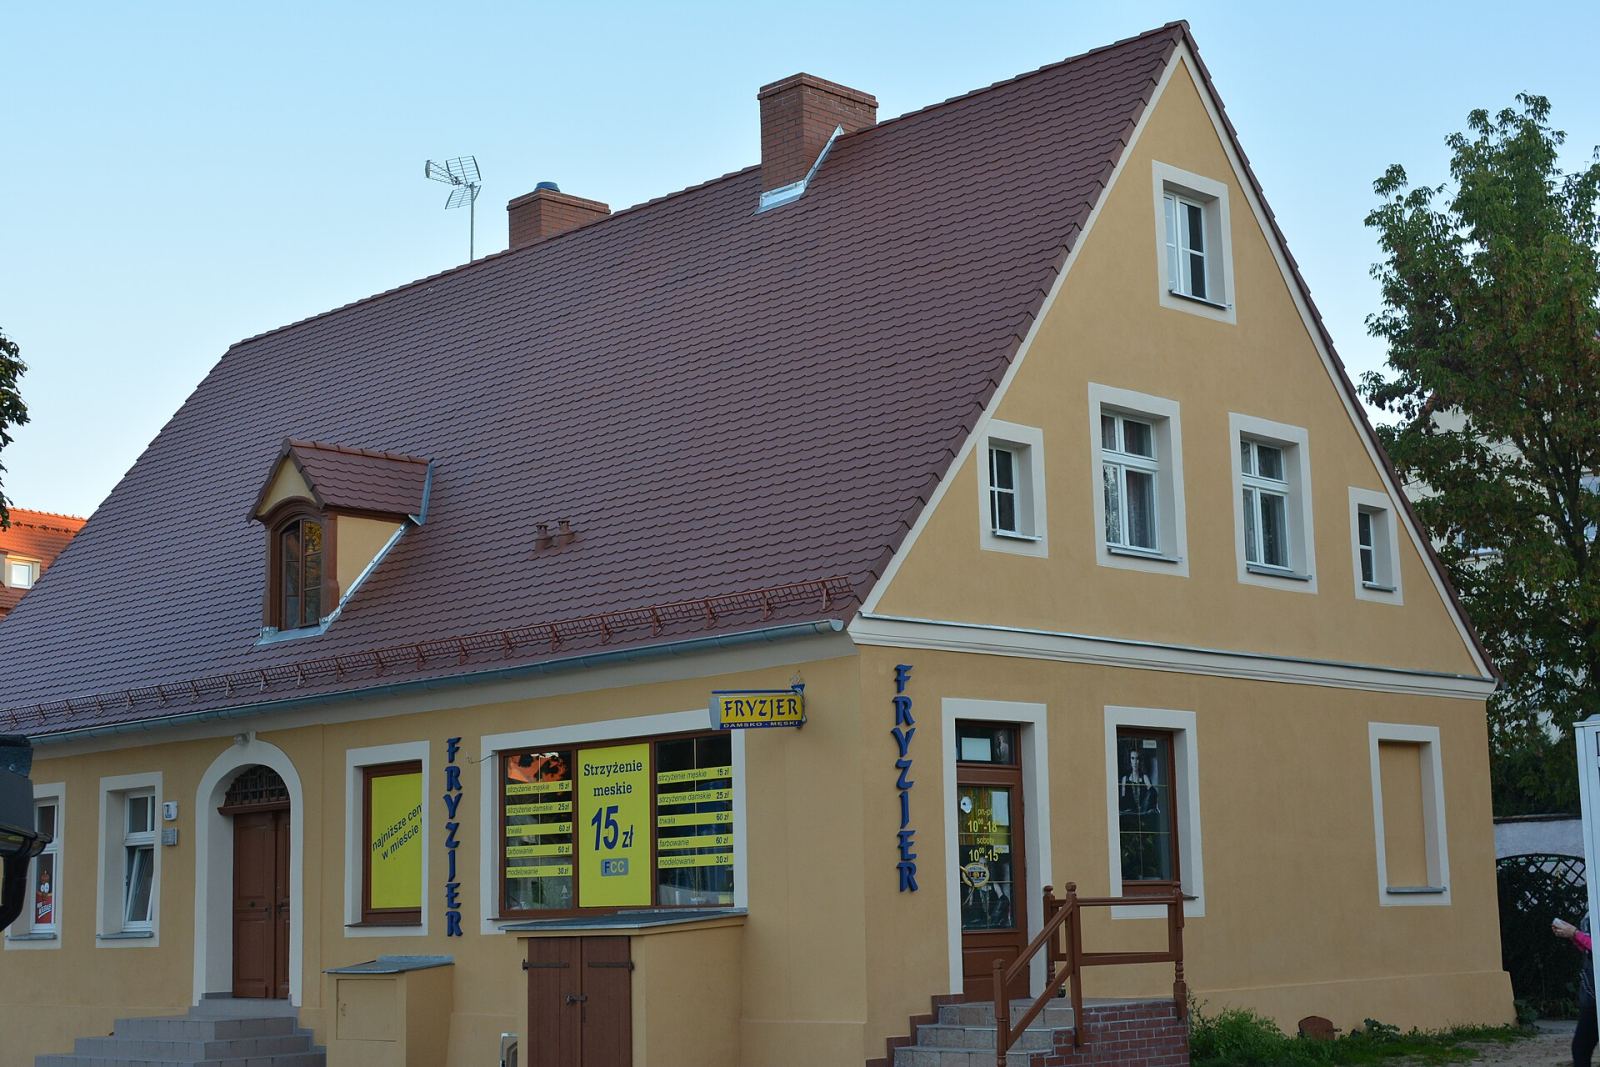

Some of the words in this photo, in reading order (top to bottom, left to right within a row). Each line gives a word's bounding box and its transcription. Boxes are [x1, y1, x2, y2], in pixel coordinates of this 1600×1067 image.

[724, 698, 799, 720] FRYZJER
[583, 760, 643, 778] Strzyżenie
[891, 664, 918, 892] FRYZJER
[593, 781, 633, 797] meskie
[716, 791, 723, 800] 25
[372, 817, 407, 851] najniższe
[407, 803, 423, 822] cen
[443, 737, 463, 937] FRYZJER
[591, 804, 620, 851] 15
[621, 824, 634, 849] zł
[381, 848, 389, 861] w
[390, 824, 419, 854] mieście
[603, 860, 625, 874] FCC
[715, 855, 723, 864] 30
